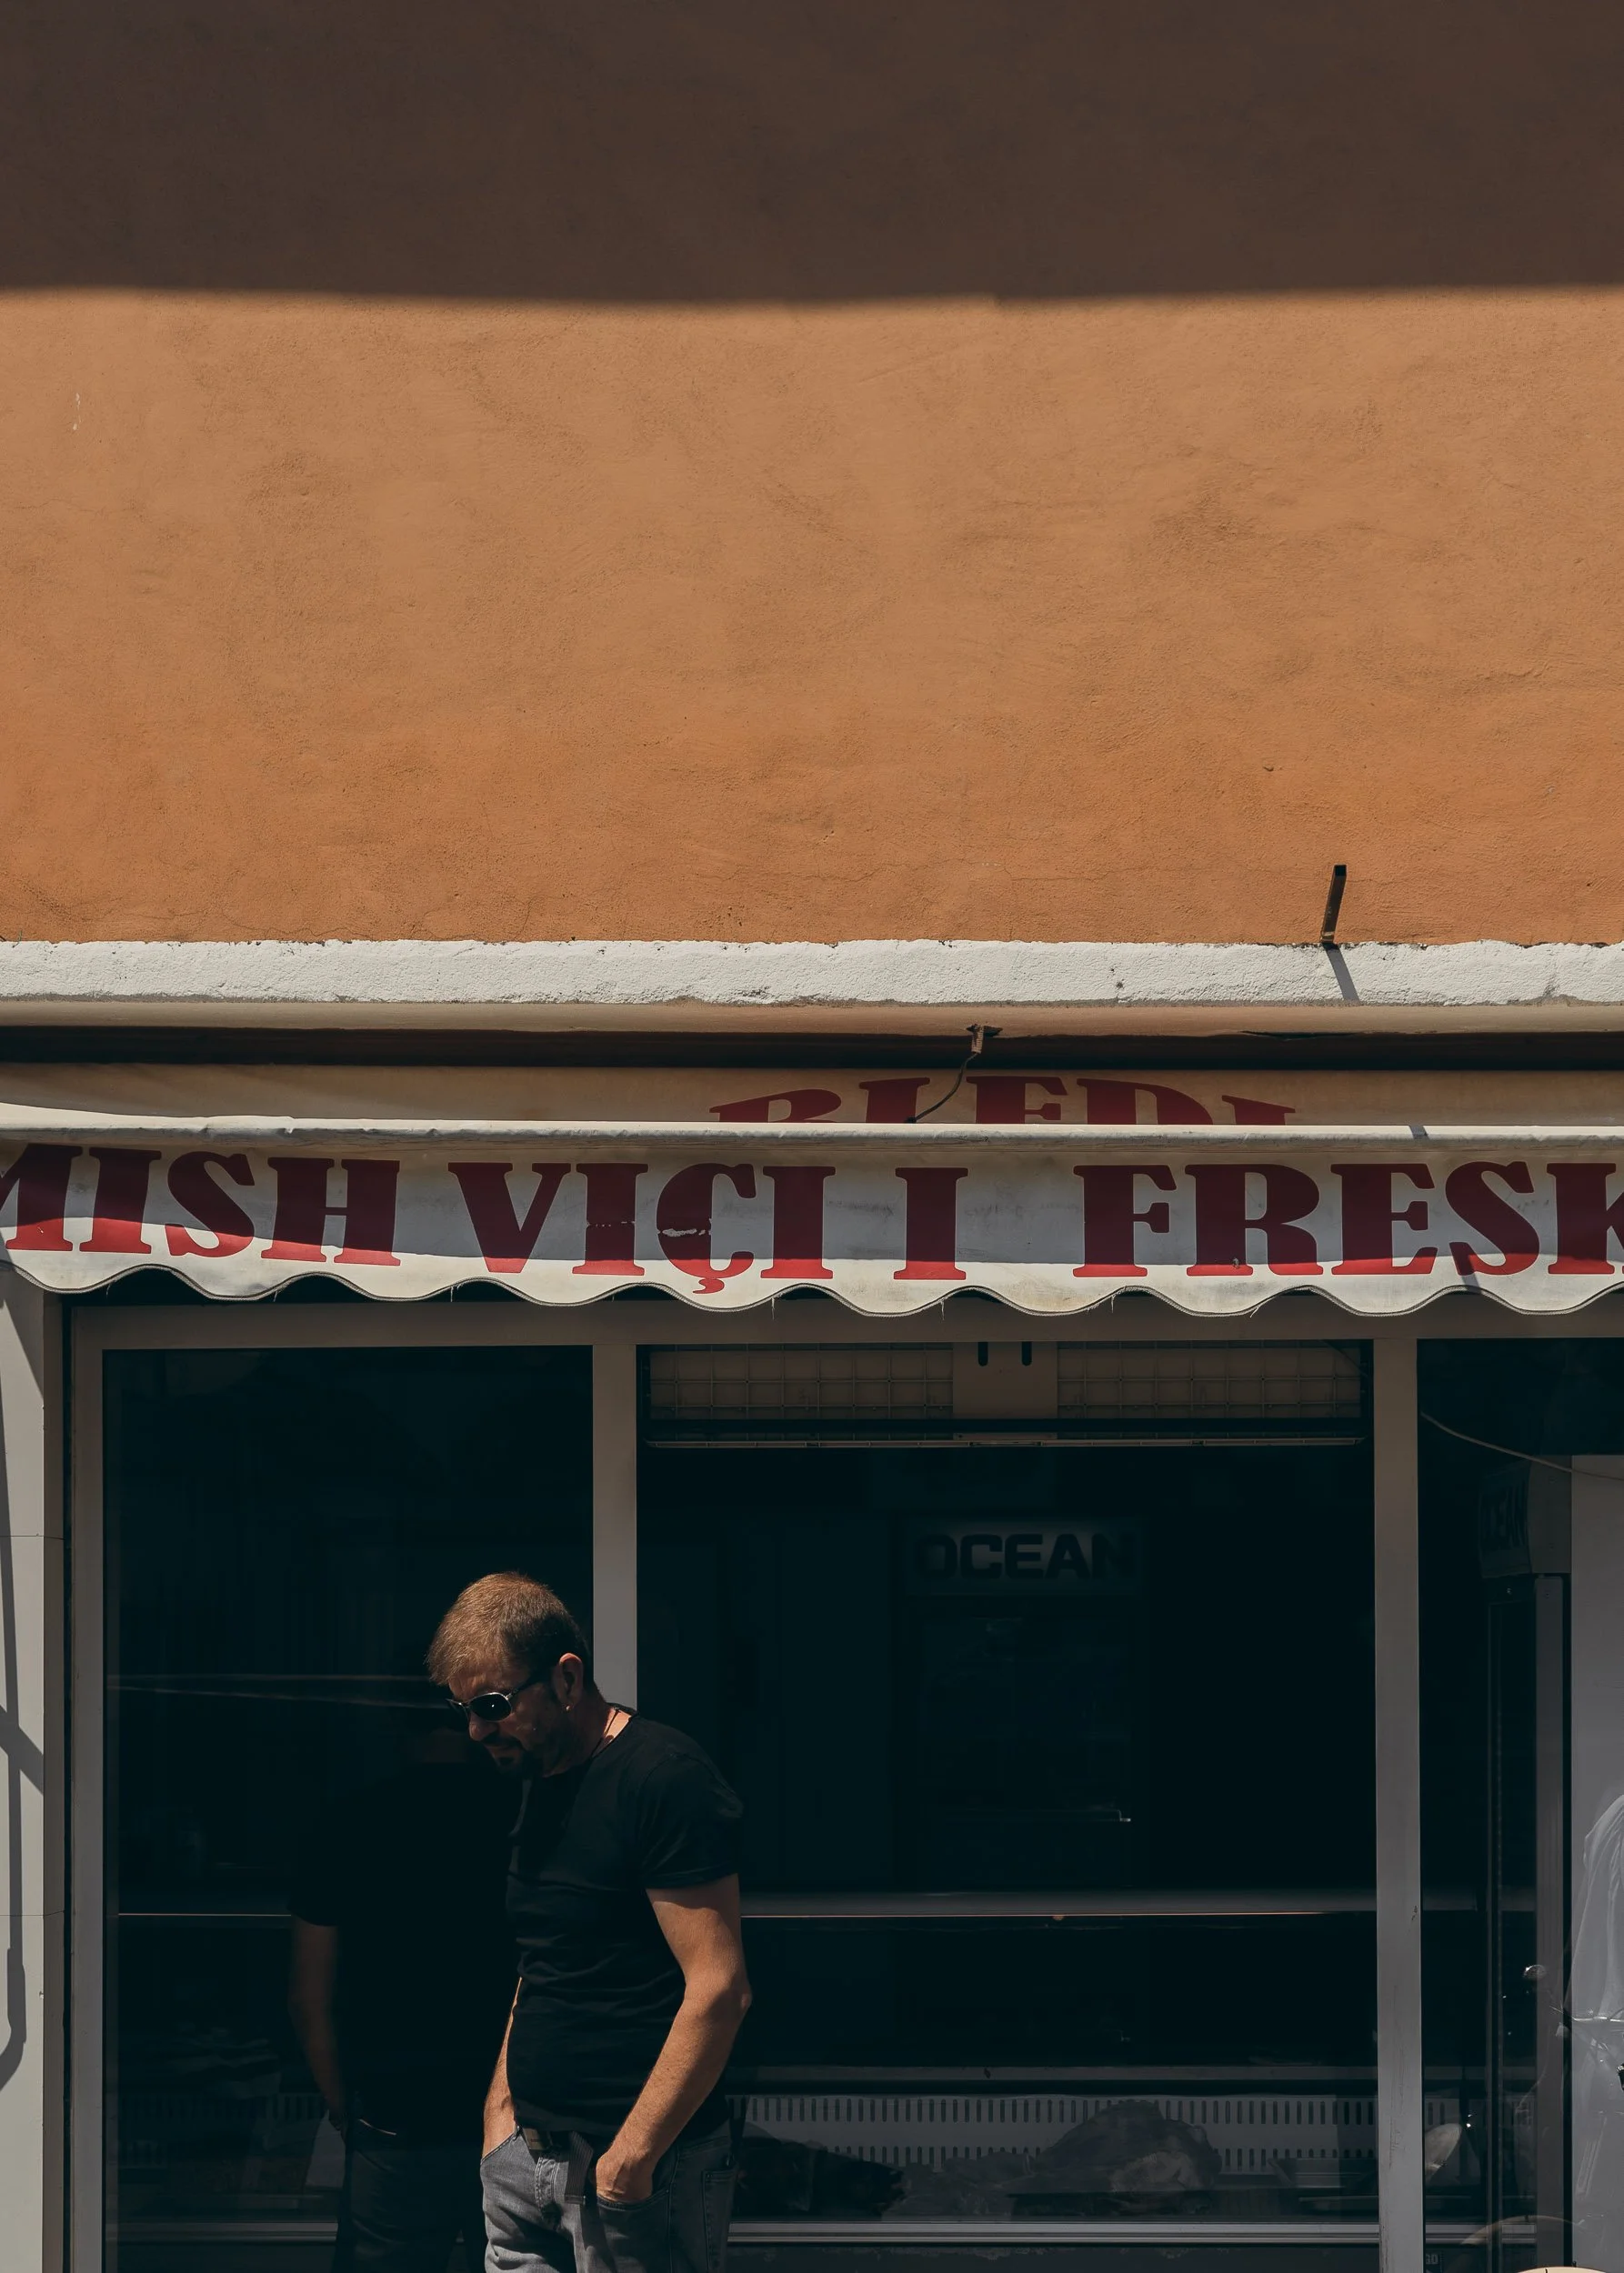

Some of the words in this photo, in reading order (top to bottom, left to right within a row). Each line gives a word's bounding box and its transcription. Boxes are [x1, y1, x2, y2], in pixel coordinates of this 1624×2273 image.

[447, 1162, 836, 1295] VIÇI
[893, 1167, 967, 1280] I
[915, 1533, 1136, 1580] OCEAN
